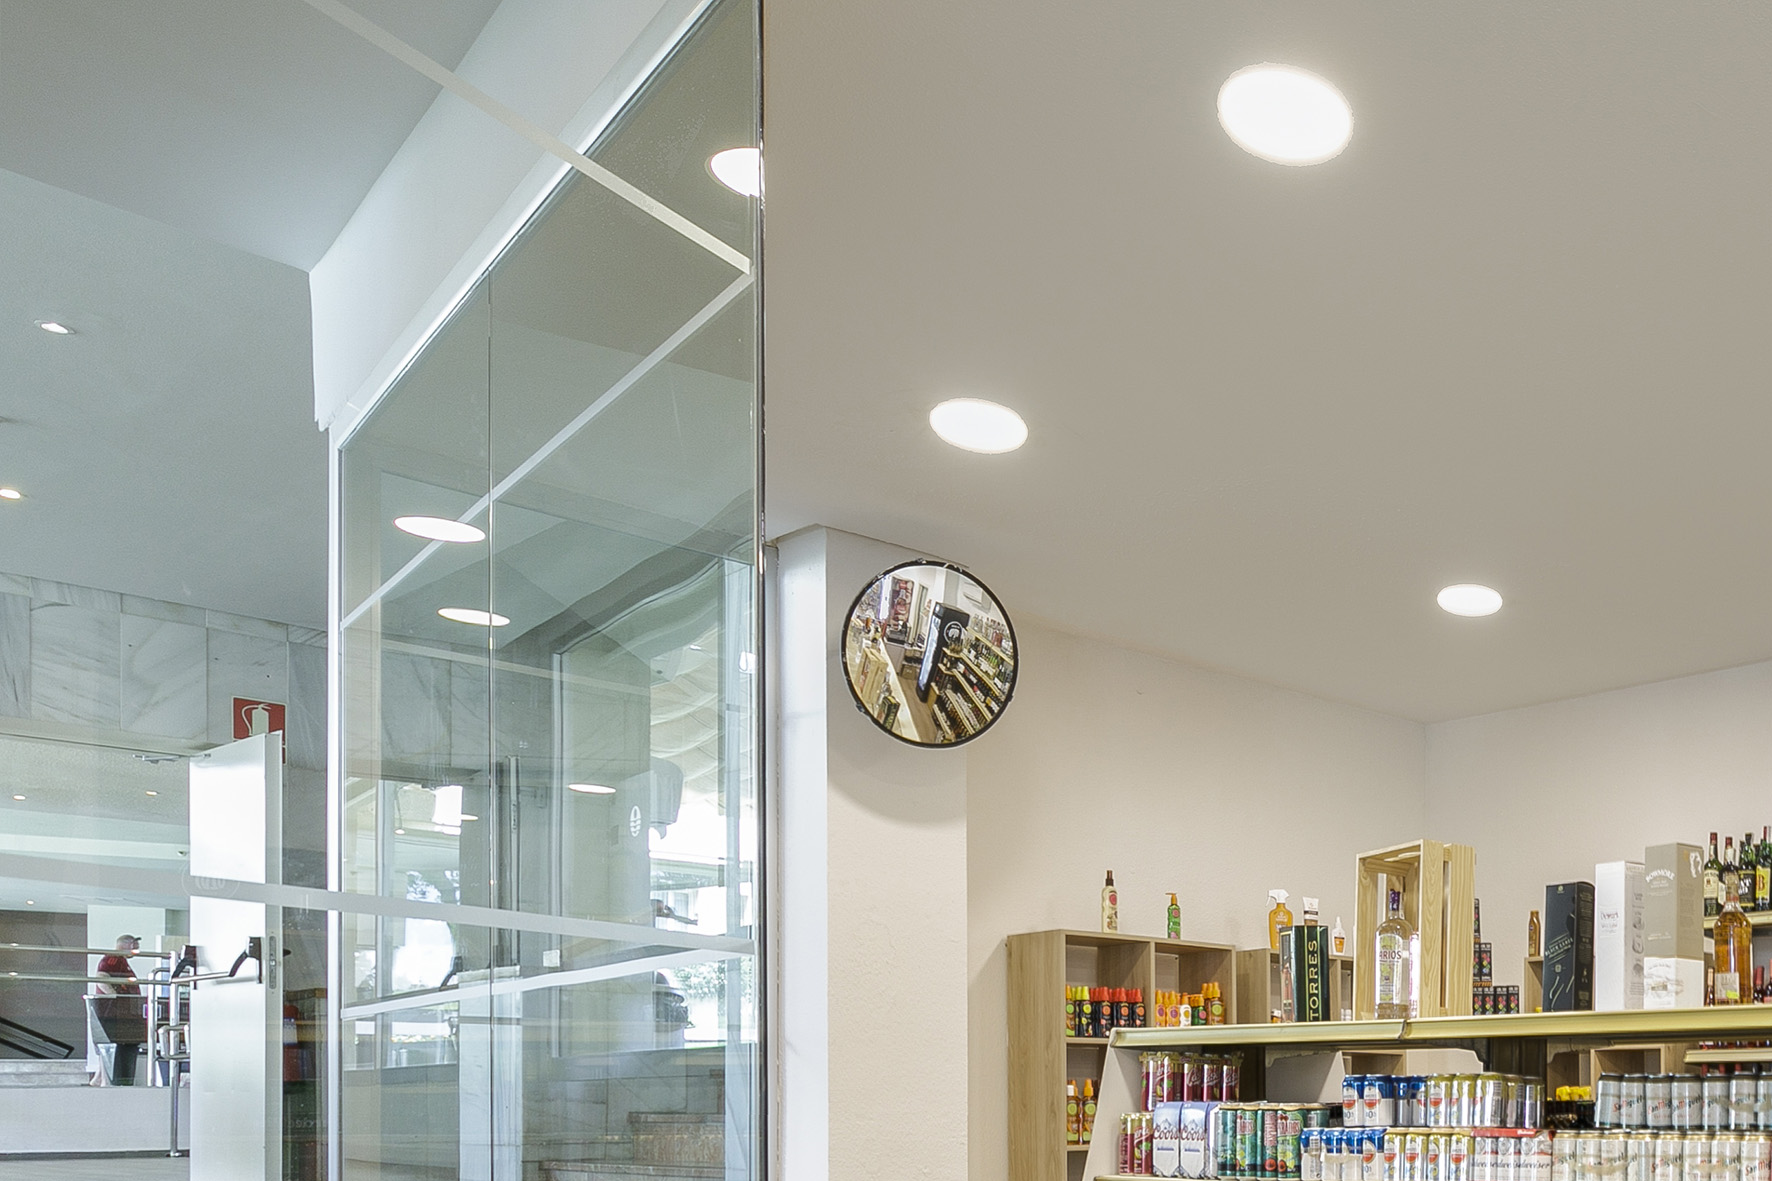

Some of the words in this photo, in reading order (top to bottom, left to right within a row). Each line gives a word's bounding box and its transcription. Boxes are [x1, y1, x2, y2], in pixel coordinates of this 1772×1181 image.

[1645, 869, 1675, 883] BOWMORE
[1379, 950, 1402, 960] ARIOS
[1308, 940, 1319, 1021] TORRES
[1154, 1125, 1179, 1141] Coors
